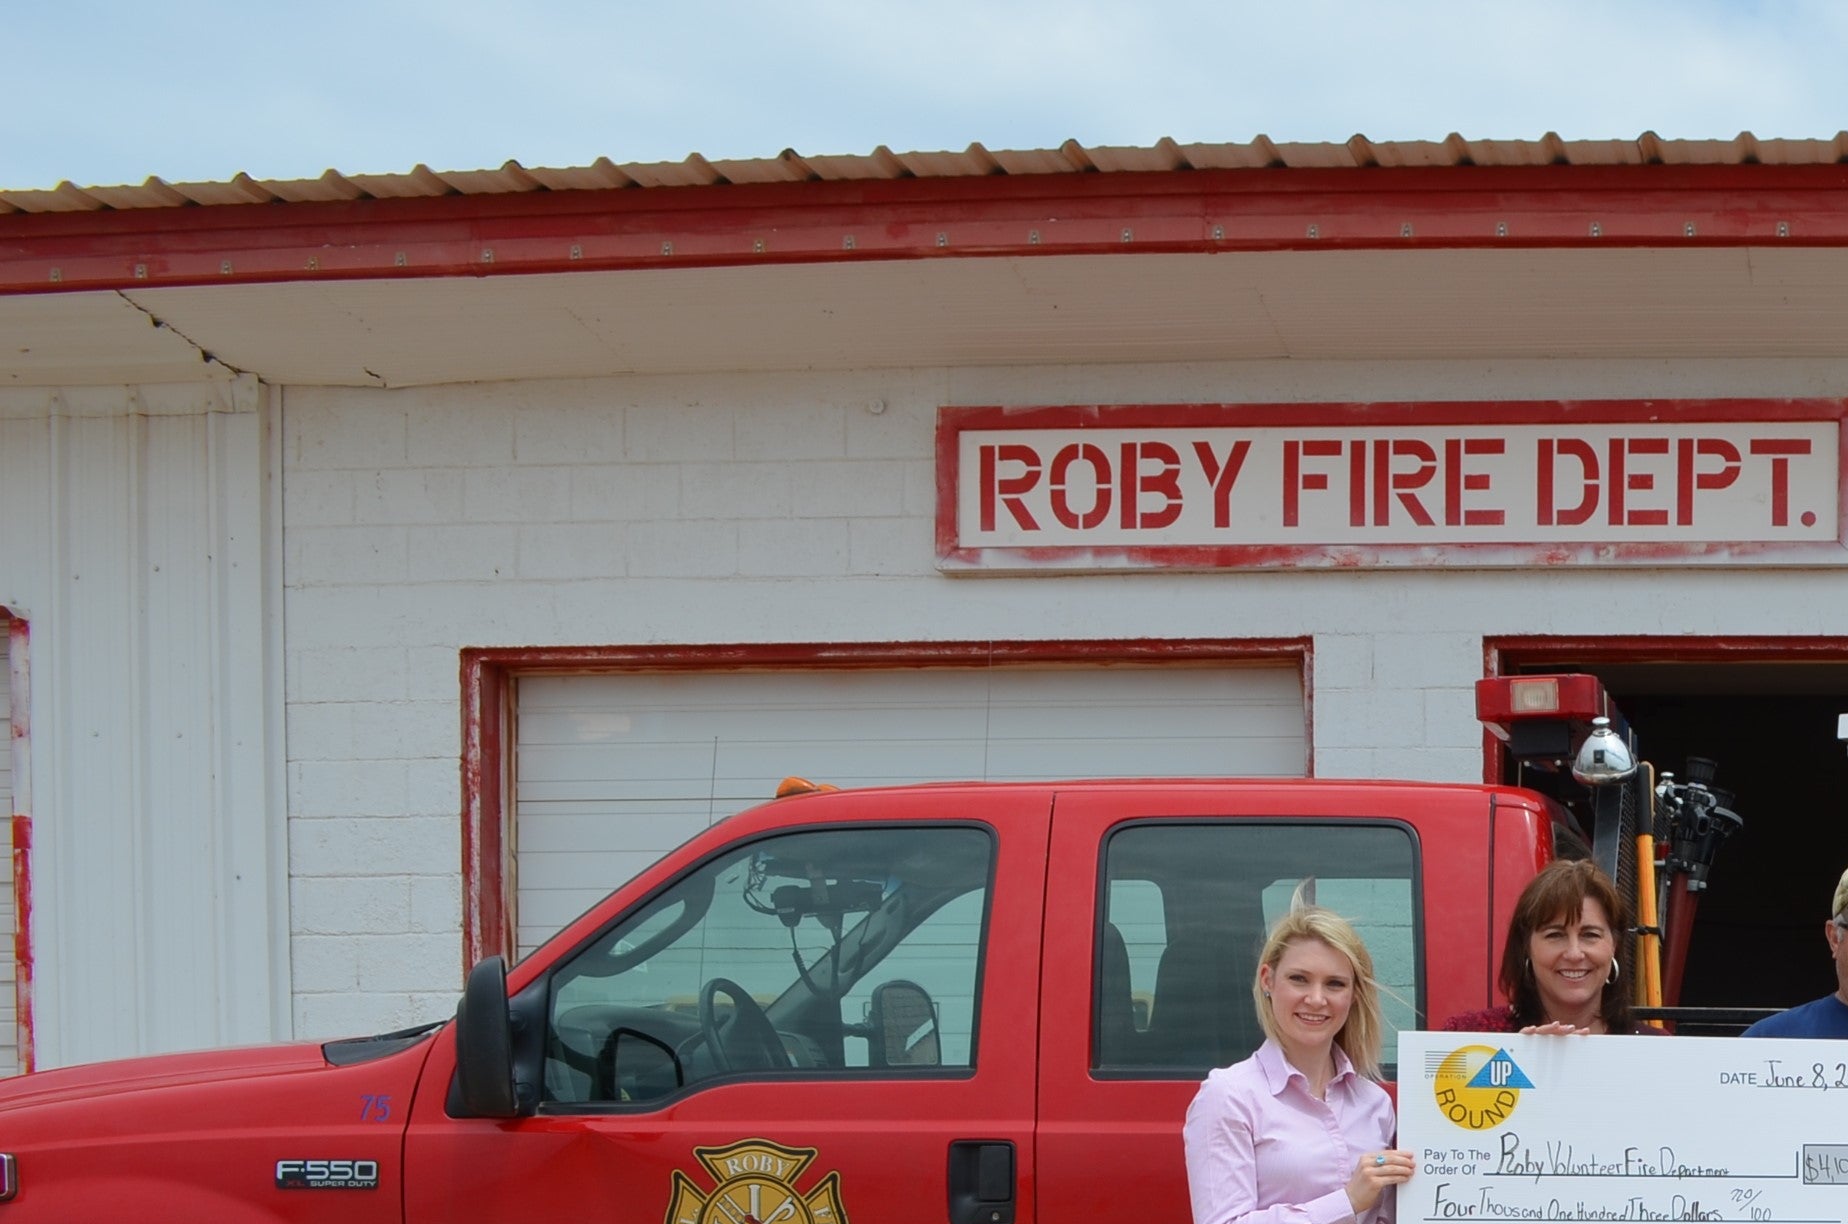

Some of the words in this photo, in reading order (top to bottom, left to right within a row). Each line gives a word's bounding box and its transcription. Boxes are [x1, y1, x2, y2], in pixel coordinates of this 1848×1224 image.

[980, 440, 1252, 531] ROBY
[1283, 437, 1506, 528] FIRE
[1537, 437, 1817, 528] DEPT.
[1490, 1060, 1512, 1086] UP
[1720, 1072, 1757, 1085] DATE
[1764, 1060, 1805, 1087] June
[1812, 1062, 1829, 1092] 8,
[361, 1094, 392, 1122] 75
[1436, 1088, 1516, 1129] ROUND
[724, 1154, 791, 1177] ROBY
[1424, 1149, 1447, 1162] Pay
[1450, 1149, 1464, 1161] To
[1468, 1149, 1491, 1161] The
[1424, 1164, 1457, 1175] Order
[1461, 1164, 1476, 1175] Of
[1496, 1132, 1544, 1184] Roby
[1547, 1141, 1622, 1176] Volunteer
[1624, 1147, 1656, 1176] Fire
[1434, 1183, 1476, 1218] Four
[1479, 1186, 1542, 1220] Thousand
[1547, 1199, 1573, 1221] One
[1576, 1201, 1628, 1222] Hundred
[1628, 1197, 1669, 1222] Three
[1671, 1194, 1723, 1222] Dollars
